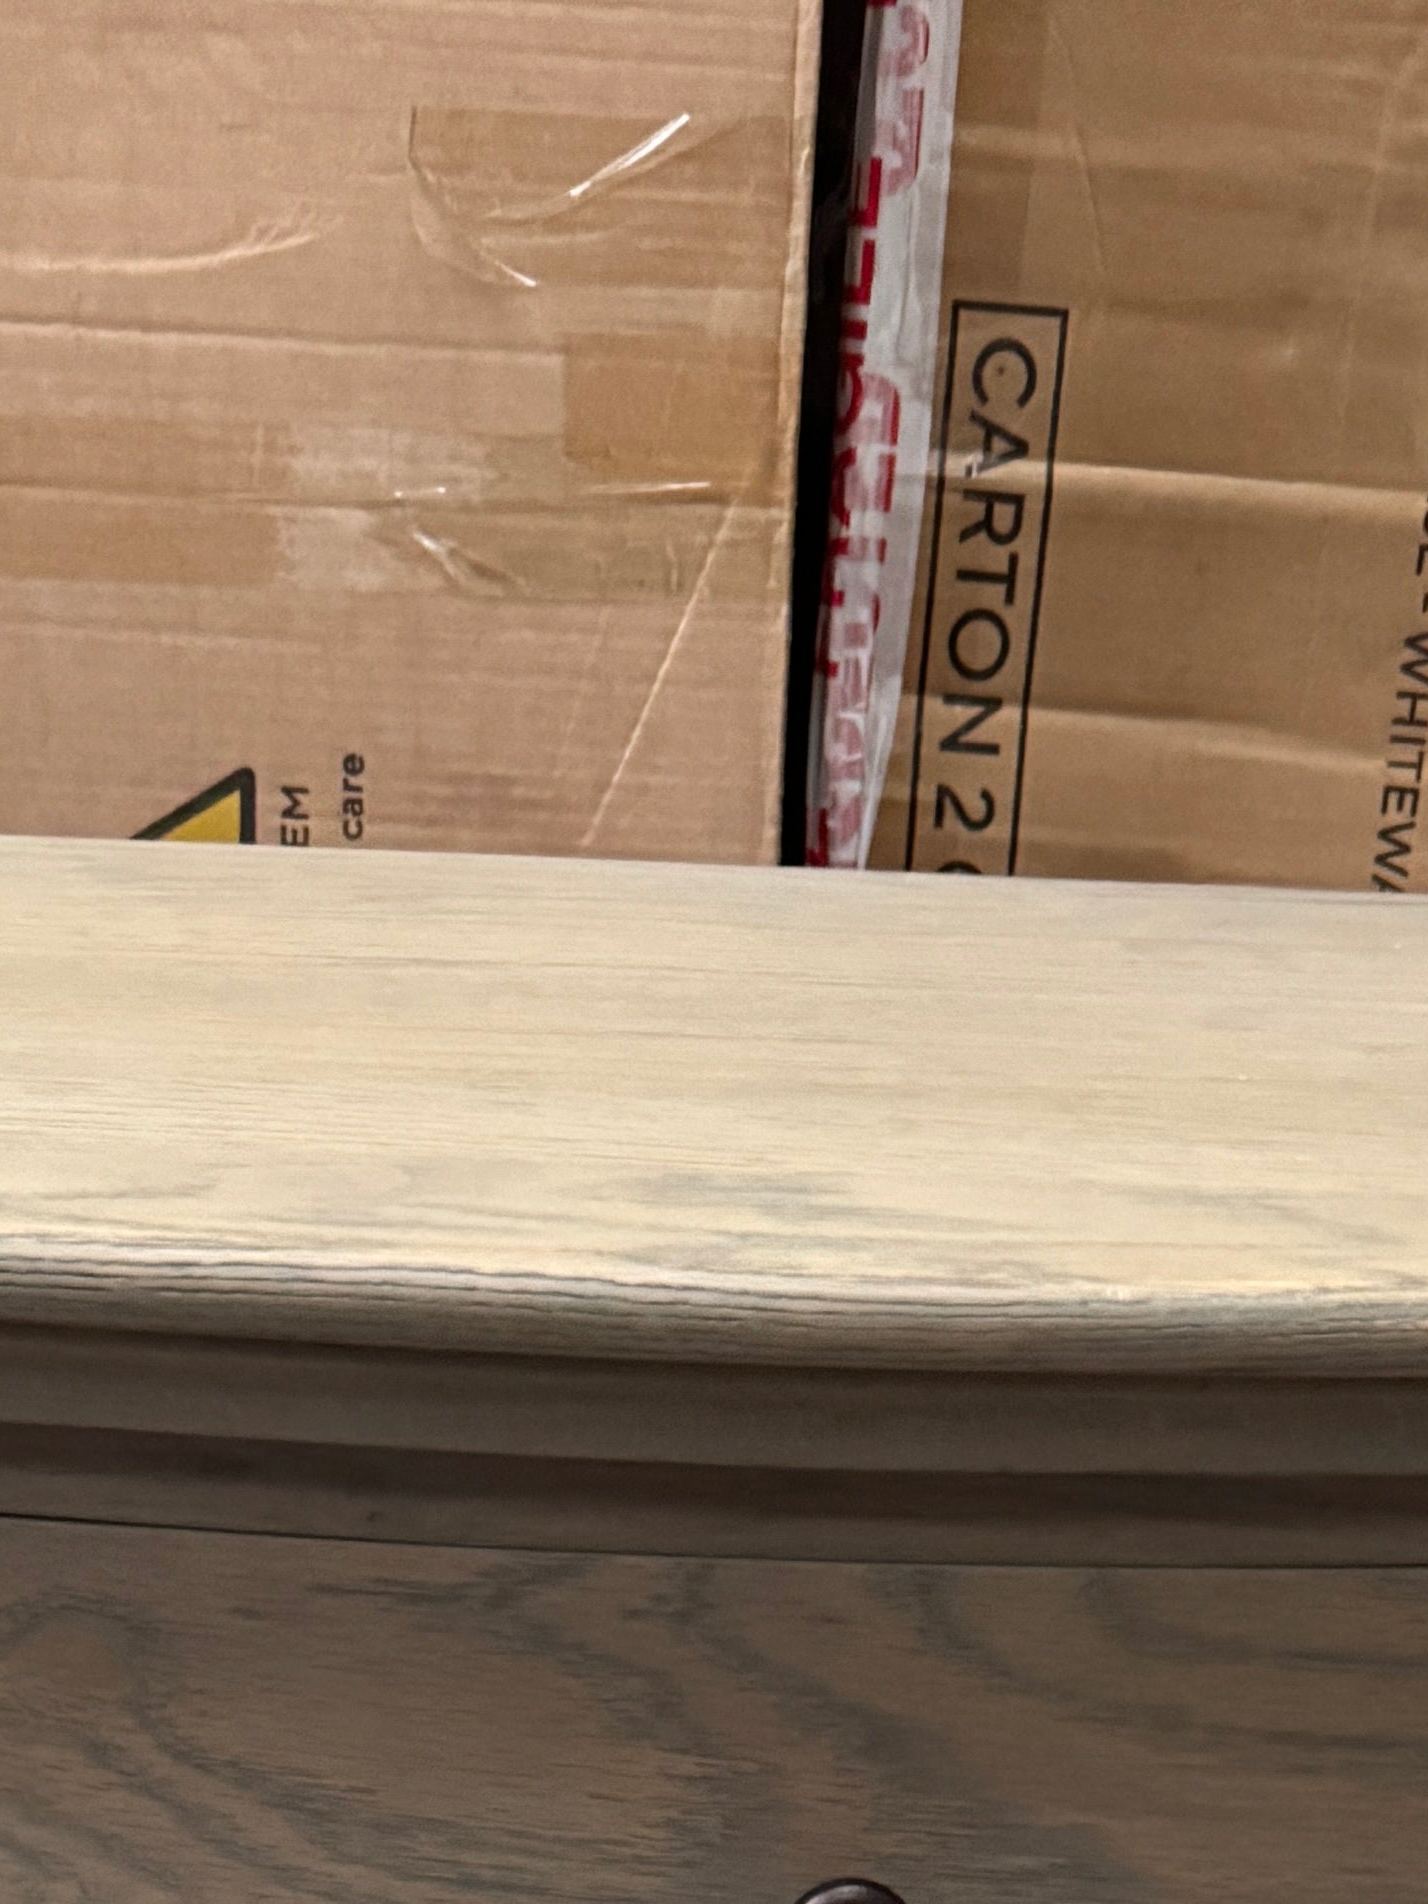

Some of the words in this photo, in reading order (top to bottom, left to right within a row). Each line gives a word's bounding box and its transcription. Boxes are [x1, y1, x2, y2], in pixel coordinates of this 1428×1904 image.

[938, 336, 1037, 758] CARTON
[337, 752, 368, 842] care
[932, 788, 998, 834] 2
